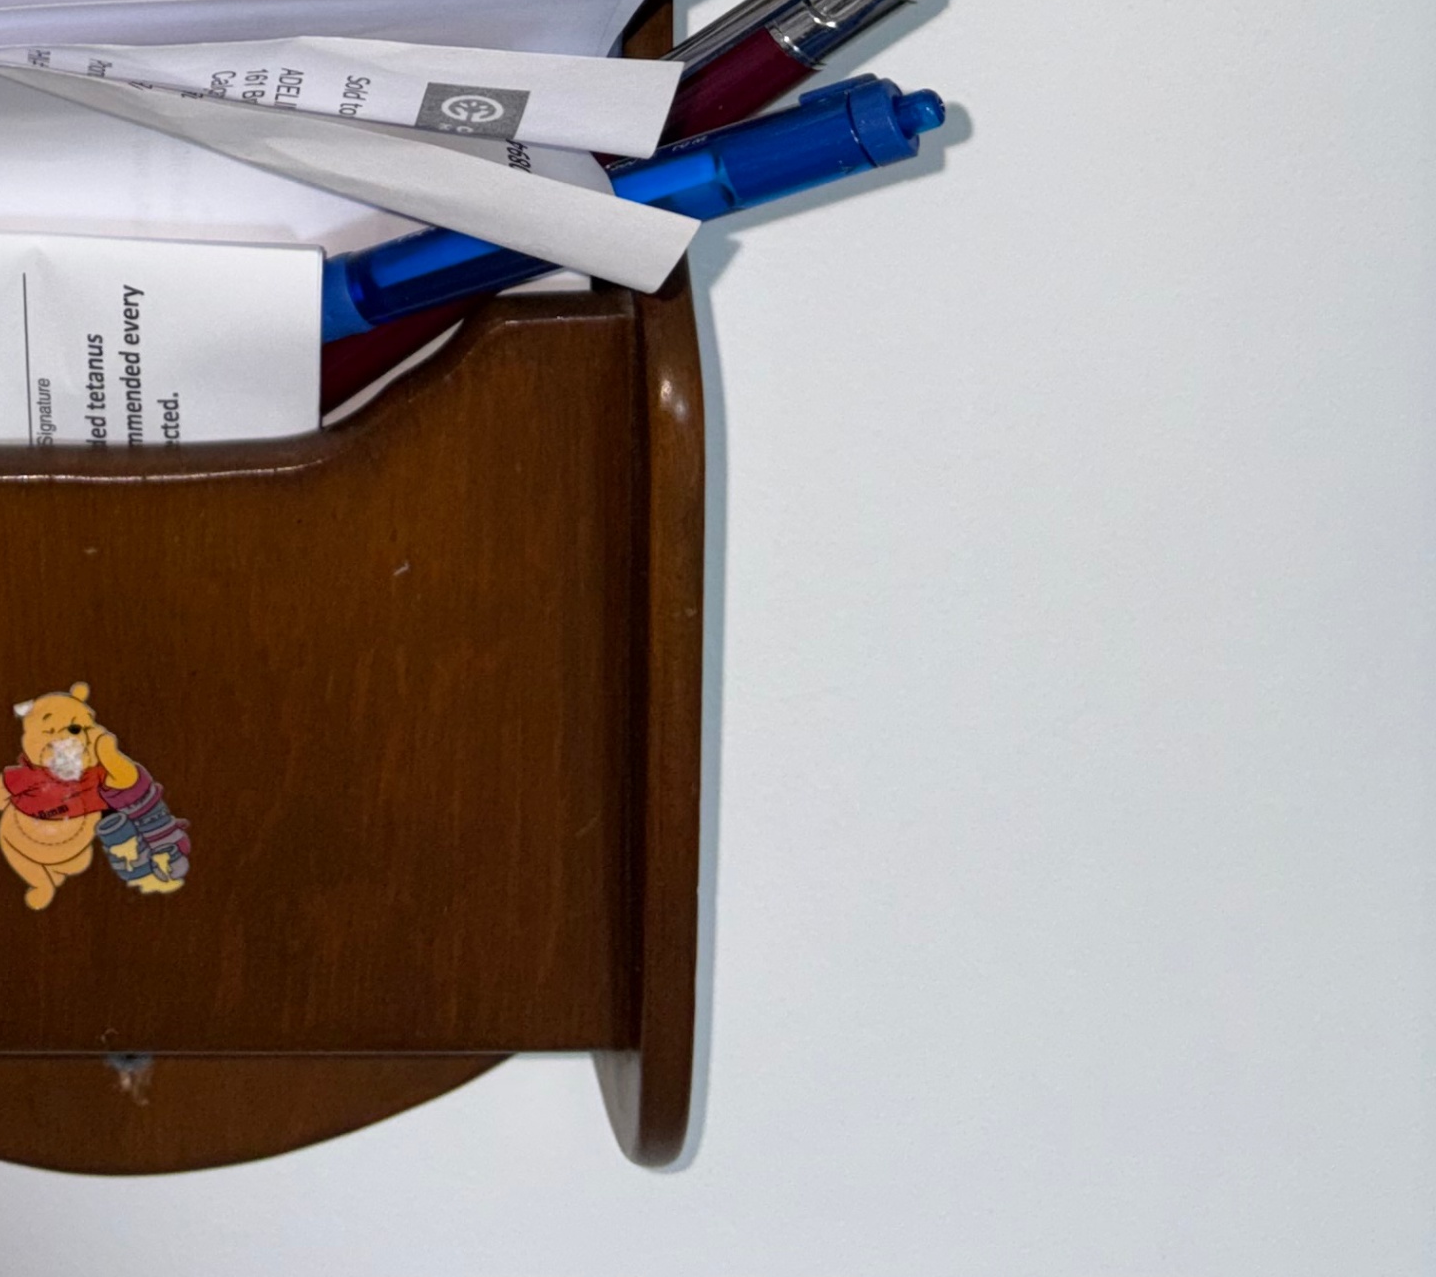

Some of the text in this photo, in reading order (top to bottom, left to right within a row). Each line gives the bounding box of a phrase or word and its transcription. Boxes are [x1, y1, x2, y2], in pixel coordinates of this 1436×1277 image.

[343, 75, 371, 101] Sold
[123, 285, 144, 345] every
[86, 334, 105, 402] tetanus
